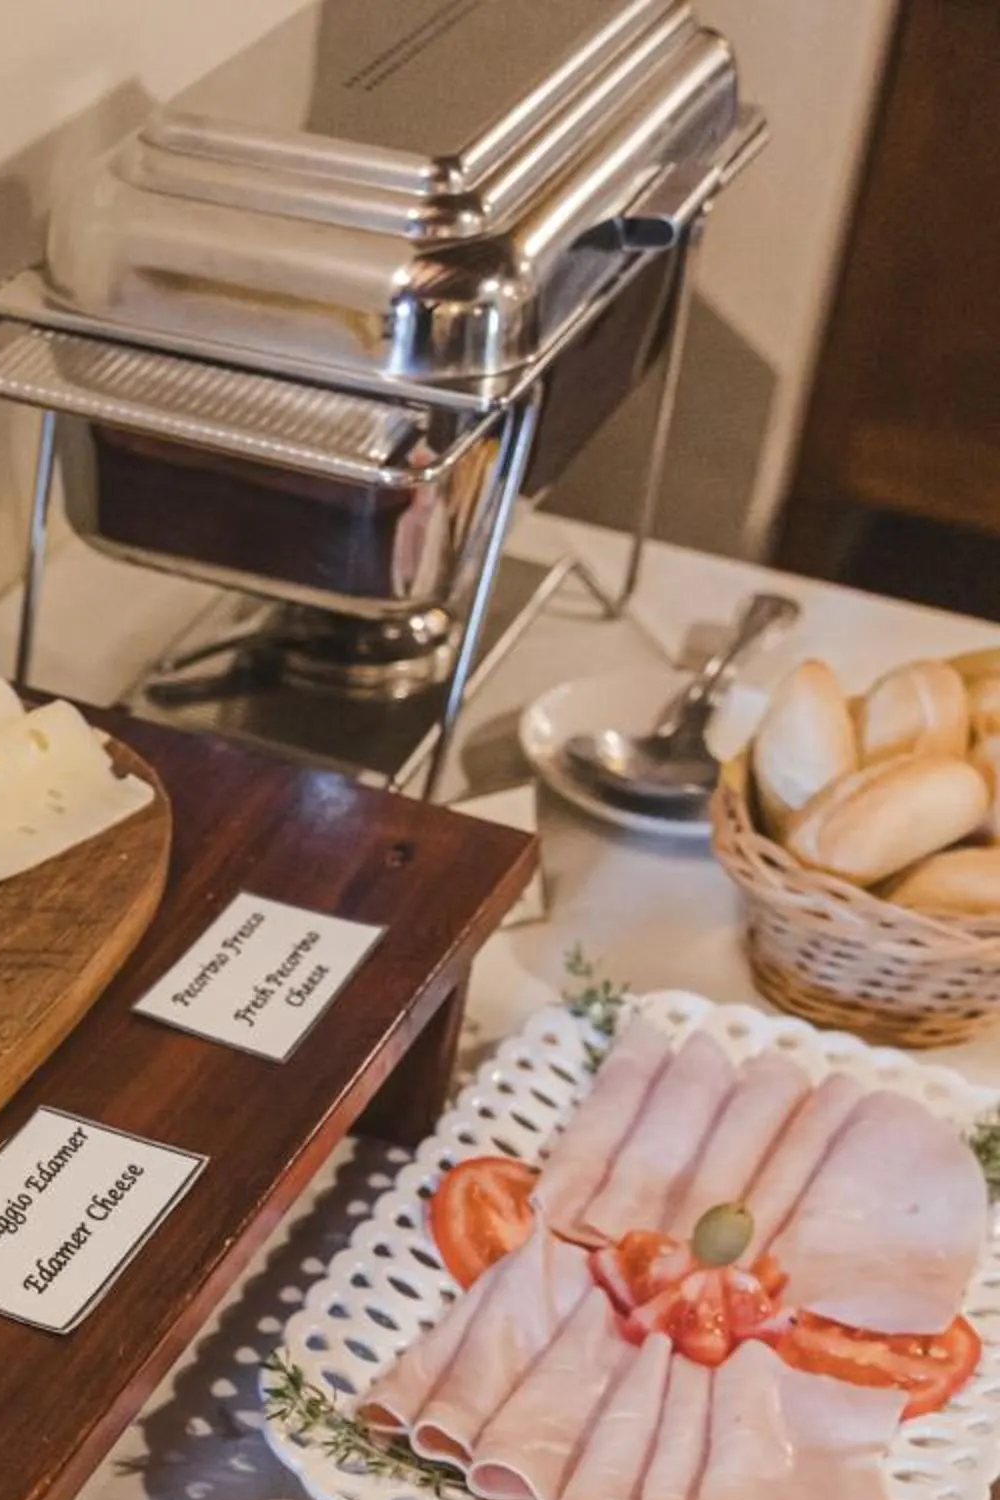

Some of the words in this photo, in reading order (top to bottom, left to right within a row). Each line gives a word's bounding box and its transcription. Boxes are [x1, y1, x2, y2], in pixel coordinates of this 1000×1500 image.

[172, 952, 230, 1008] Pecorino
[221, 912, 265, 955] Fresco
[234, 982, 275, 1027] Fresh
[266, 931, 321, 986] Pecorino
[285, 965, 330, 1008] Cheese
[25, 1127, 89, 1193] Edamer
[23, 1222, 93, 1295] Edamer
[86, 1163, 144, 1222] Cheese
